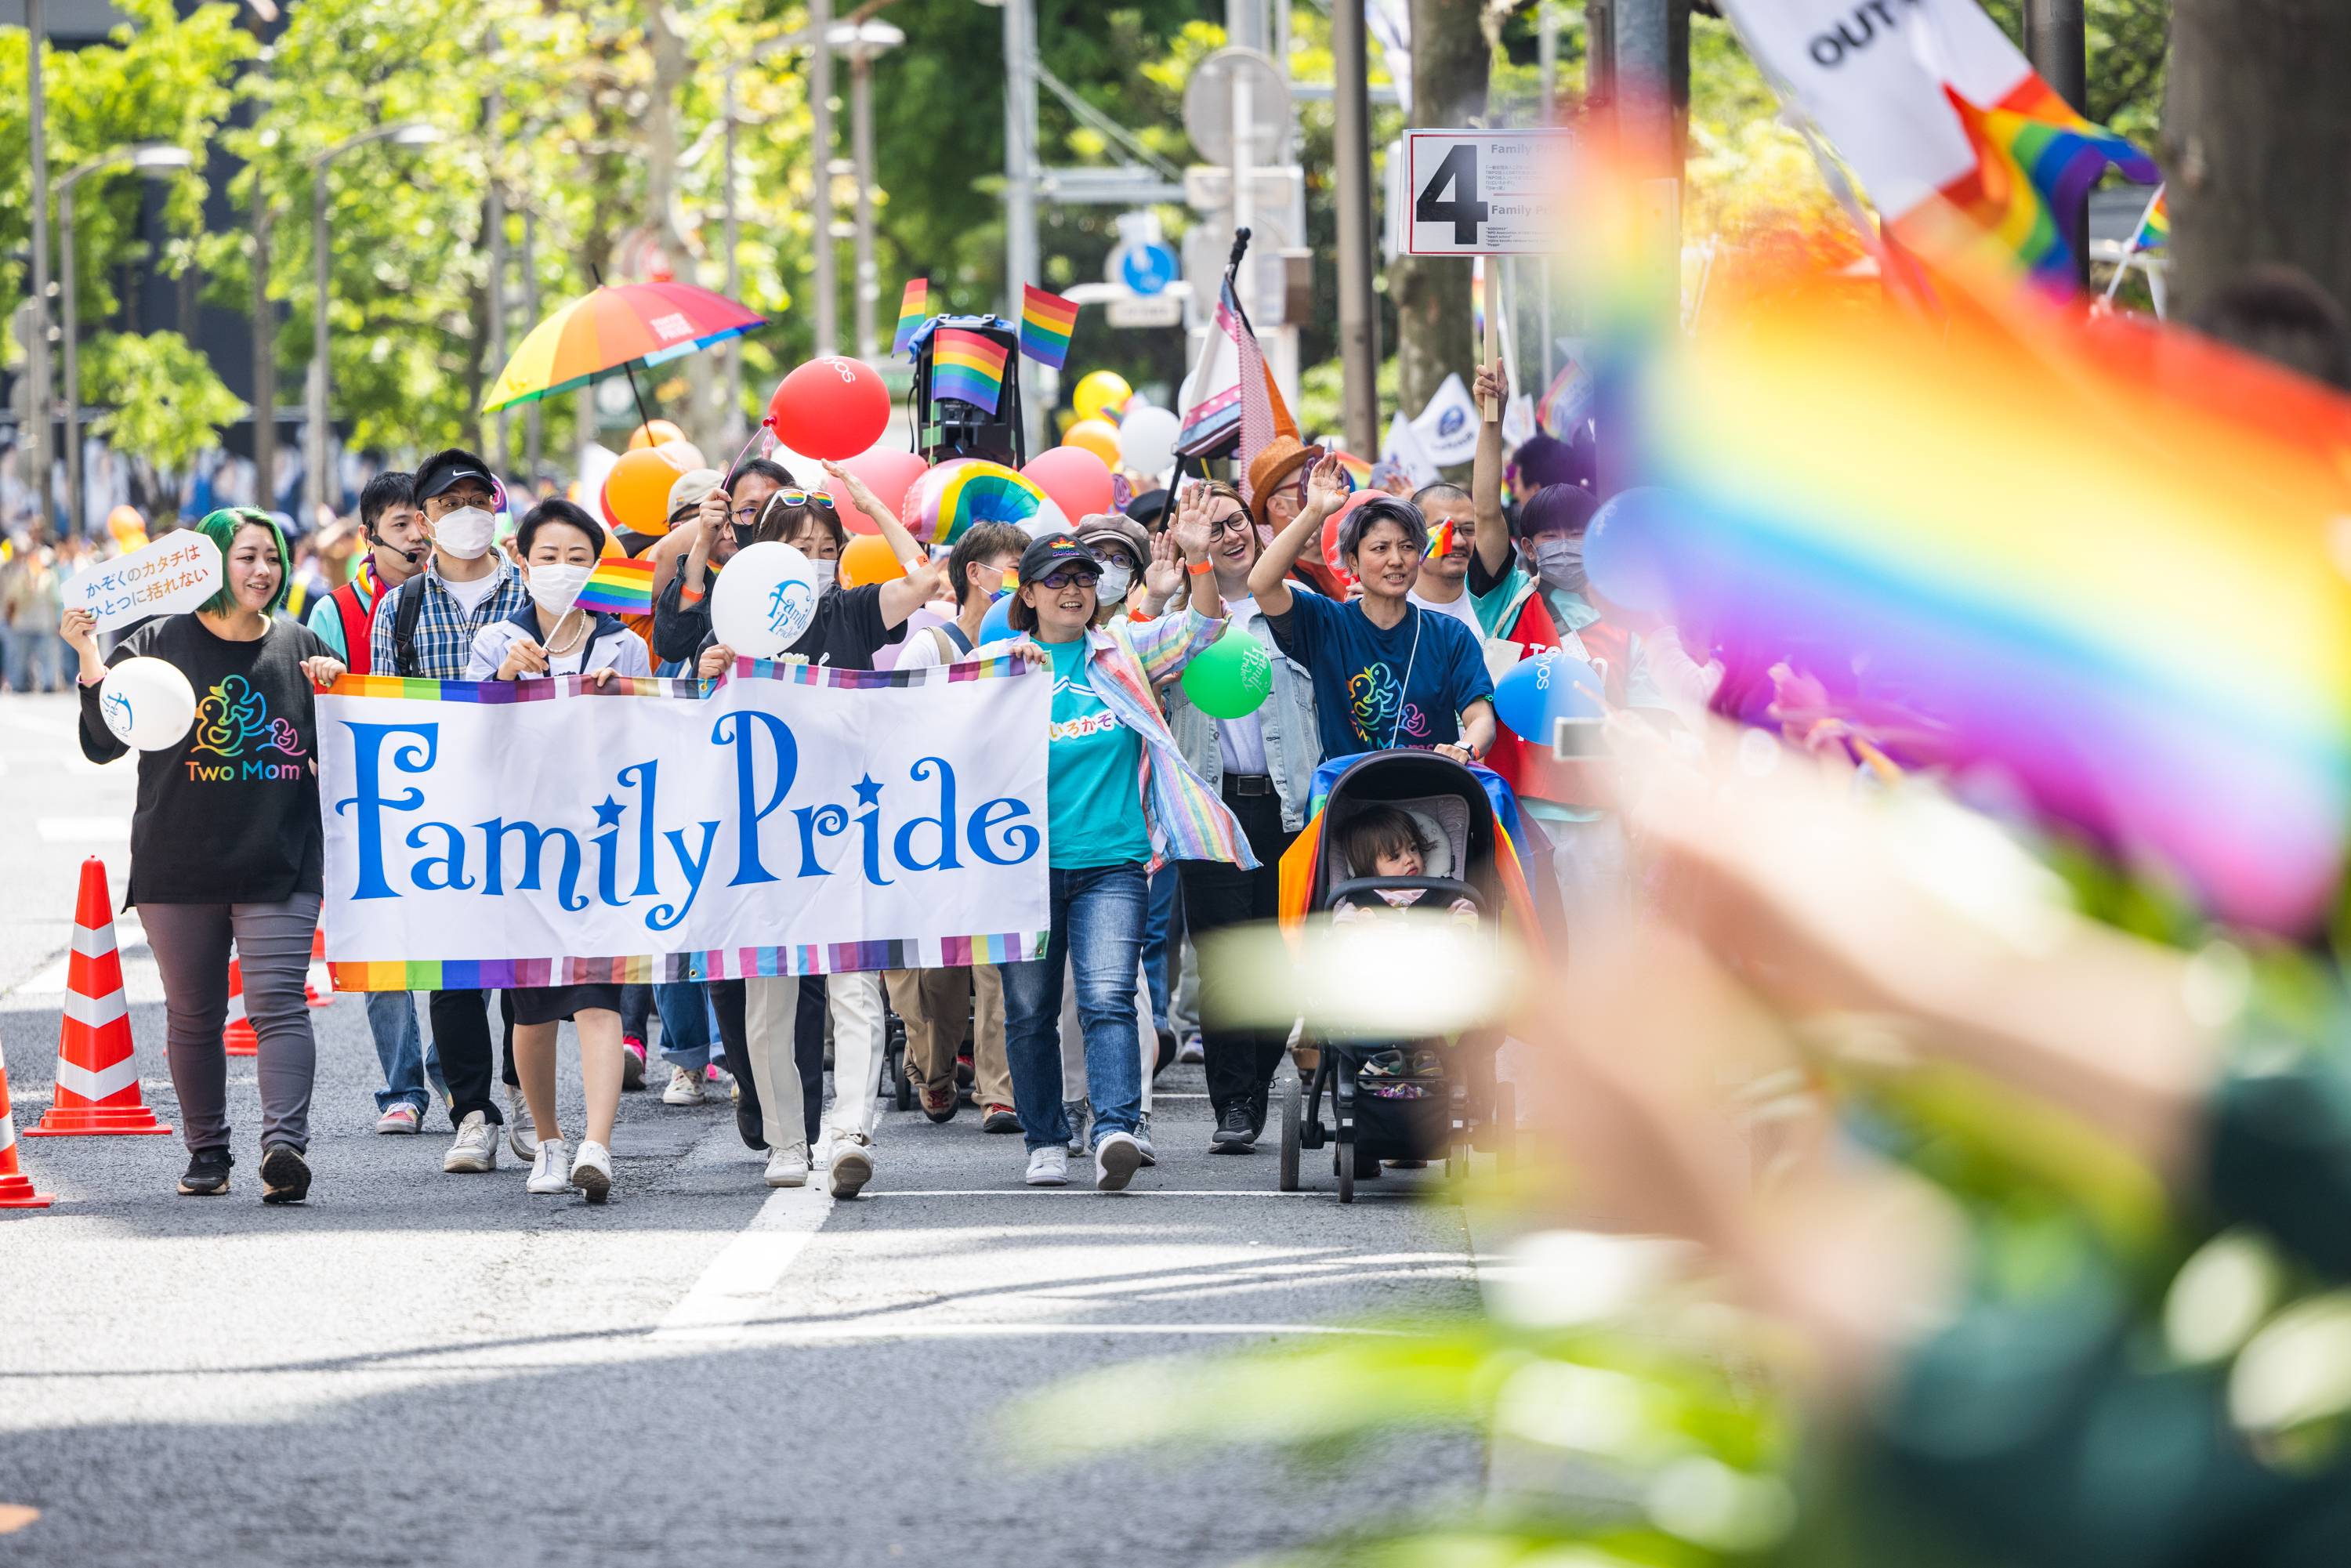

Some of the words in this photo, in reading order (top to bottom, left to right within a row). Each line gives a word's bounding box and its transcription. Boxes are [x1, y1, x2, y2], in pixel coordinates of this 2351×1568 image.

[1491, 144, 1533, 155] Family
[1416, 144, 1488, 244] 4
[1491, 205, 1534, 216] Family
[85, 544, 201, 599] かぞくのカタチは
[87, 568, 208, 619] ひとつに括れない
[767, 579, 815, 633] Family
[767, 611, 795, 639] Pride
[185, 761, 234, 781] Two
[242, 760, 304, 780] Mom
[335, 719, 721, 930] Family
[710, 710, 1040, 887] Pride
